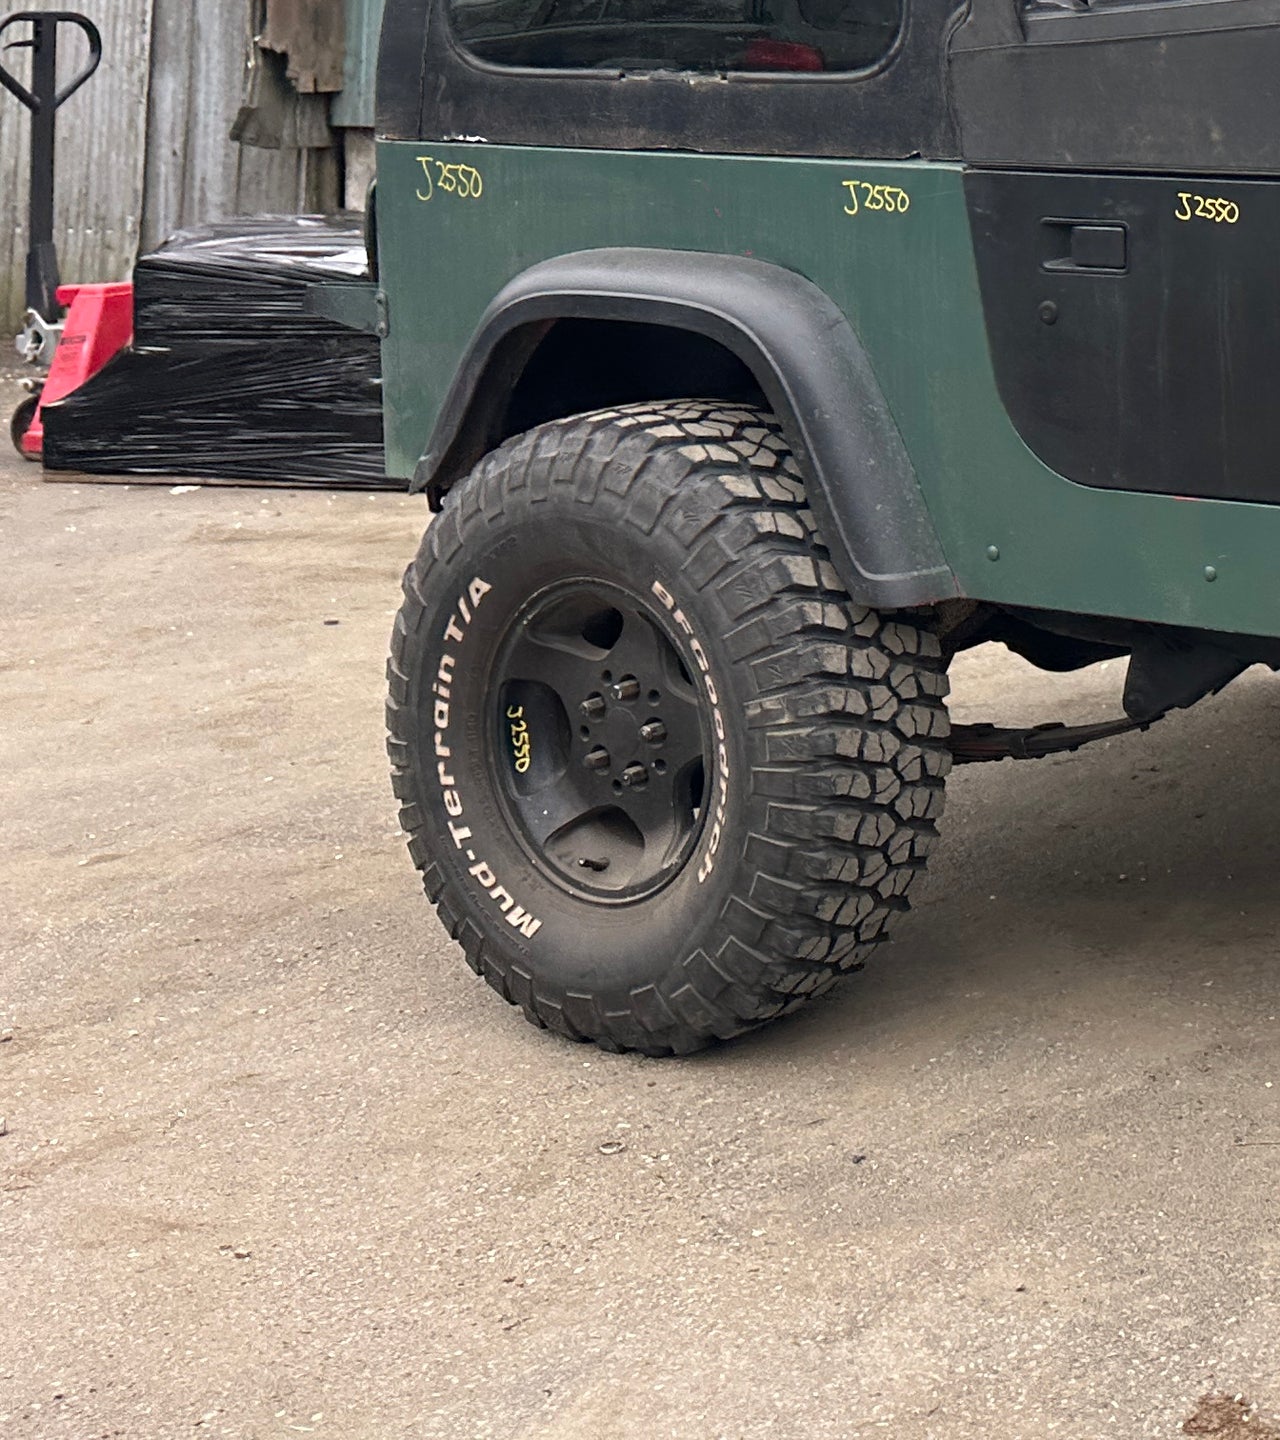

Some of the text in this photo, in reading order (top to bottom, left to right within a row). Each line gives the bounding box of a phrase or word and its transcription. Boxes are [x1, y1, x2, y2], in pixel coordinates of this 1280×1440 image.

[415, 156, 483, 201] J2550
[841, 180, 910, 215] J2550
[1174, 192, 1240, 224] J2550
[442, 576, 492, 643] T/A
[506, 705, 531, 773] J2550
[432, 653, 543, 939] Mud-Terrain
